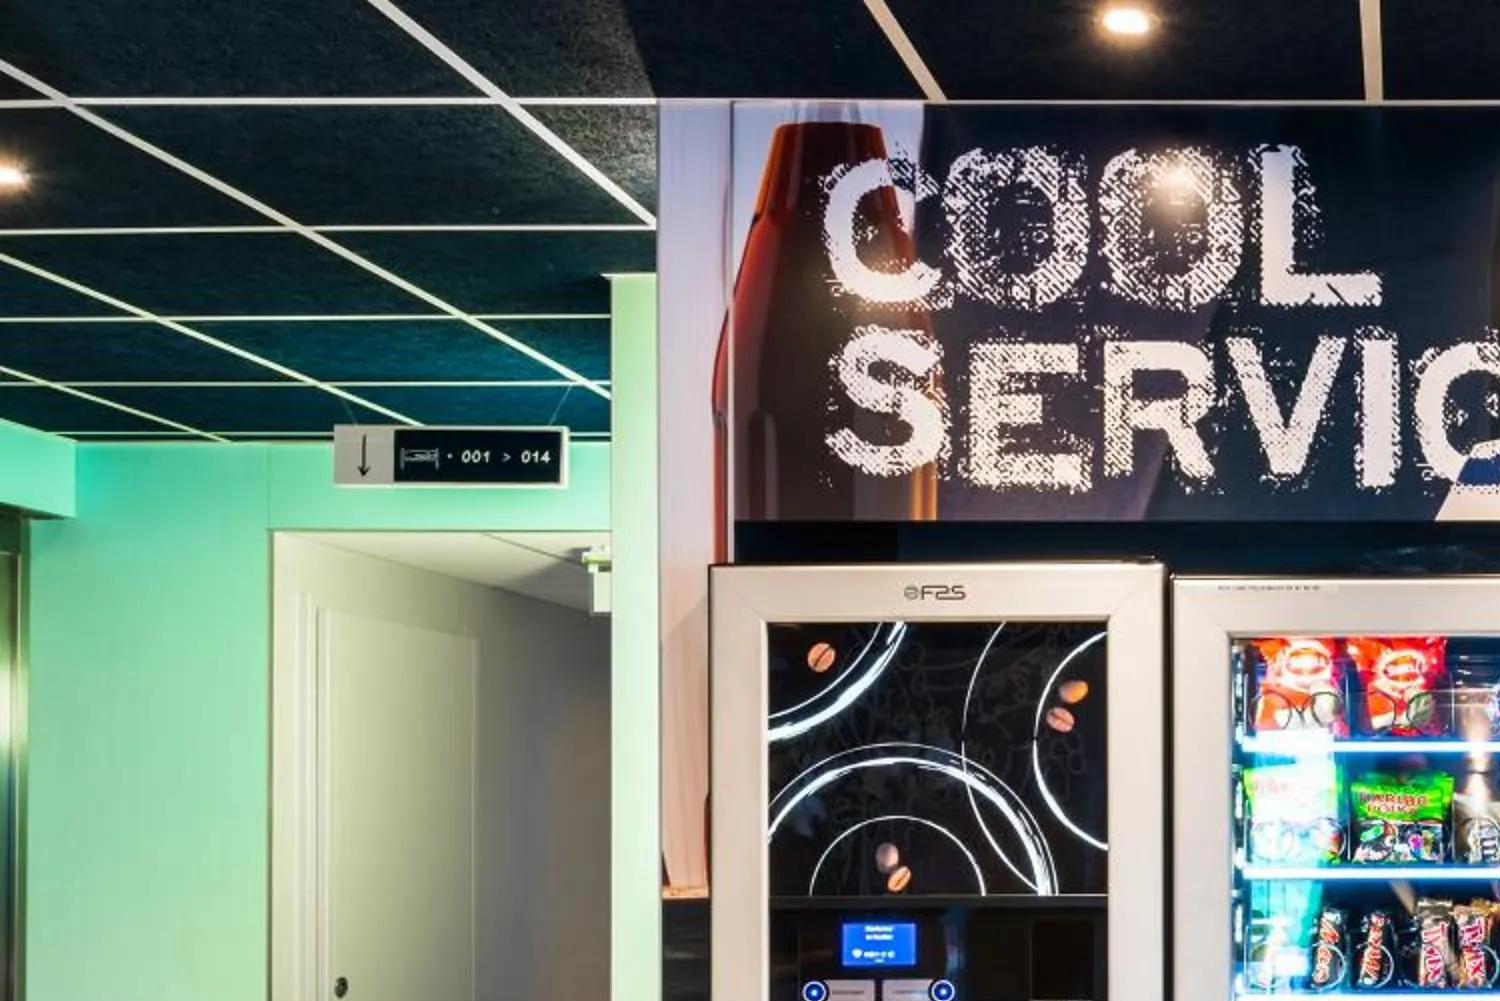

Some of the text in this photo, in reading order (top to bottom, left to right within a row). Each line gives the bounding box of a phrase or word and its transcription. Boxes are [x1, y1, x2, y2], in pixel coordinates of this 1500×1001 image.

[820, 144, 1383, 310] COOL
[461, 450, 491, 463] 001
[521, 450, 551, 463] 014
